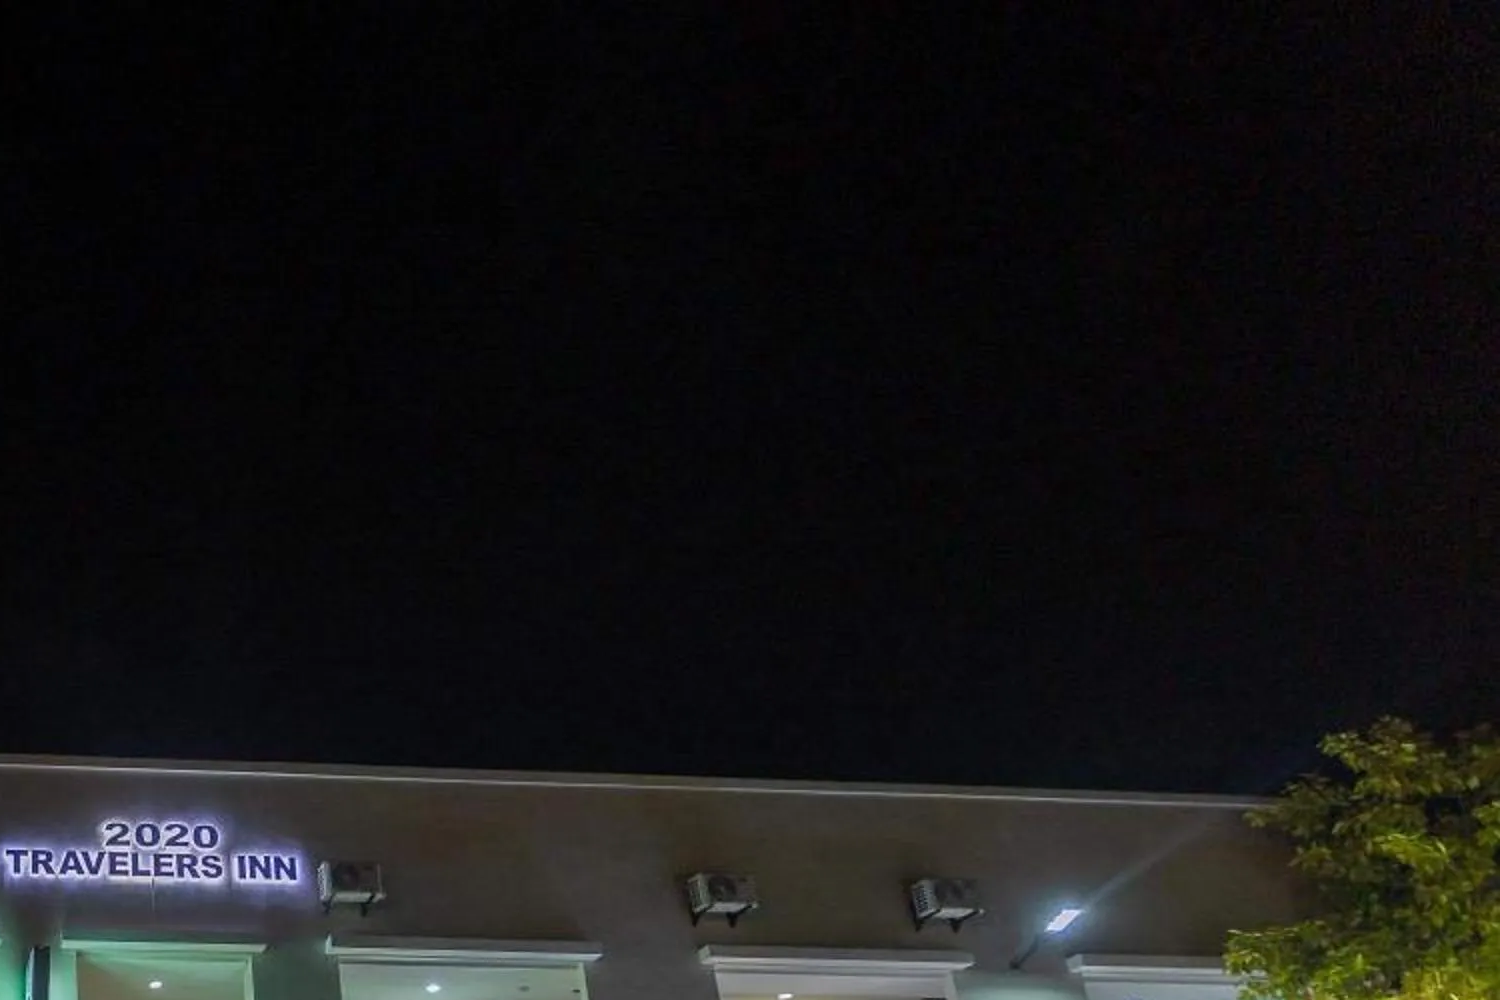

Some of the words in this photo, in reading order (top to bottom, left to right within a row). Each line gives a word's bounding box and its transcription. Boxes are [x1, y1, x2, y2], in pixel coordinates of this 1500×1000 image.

[104, 822, 219, 849] 2020
[5, 849, 223, 879] TRAVELERS
[237, 854, 298, 881] INN
